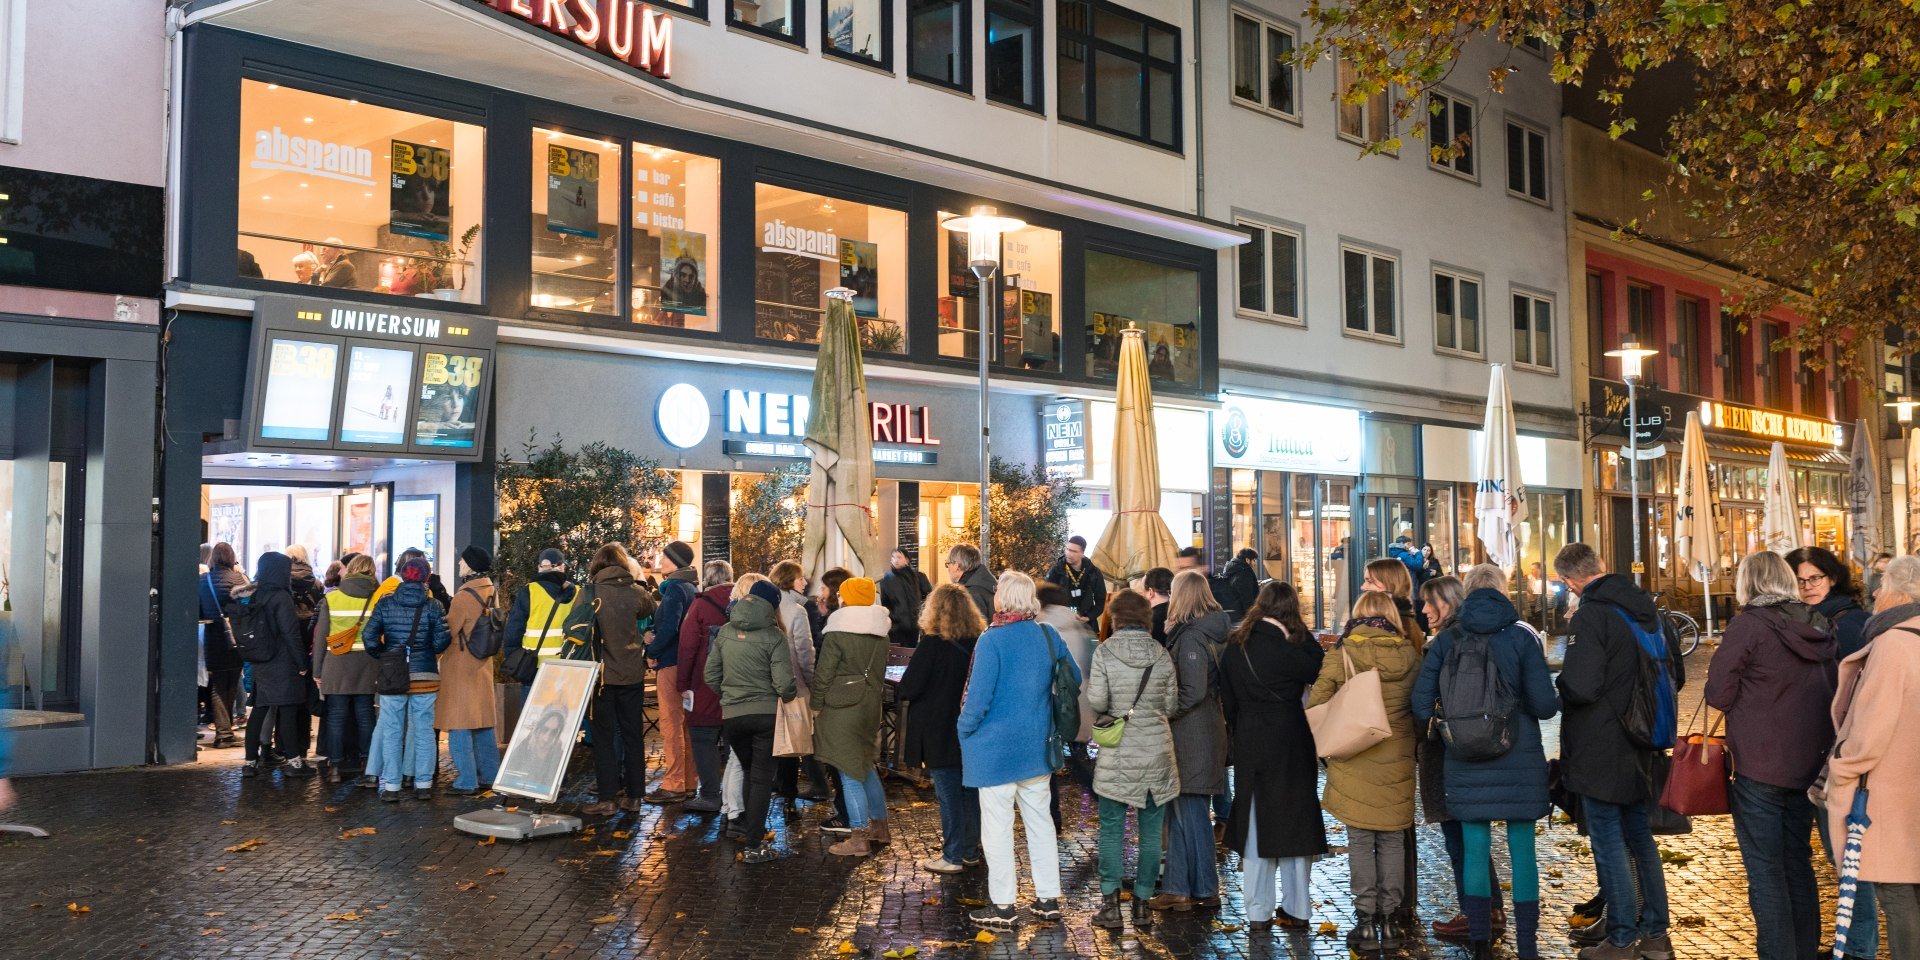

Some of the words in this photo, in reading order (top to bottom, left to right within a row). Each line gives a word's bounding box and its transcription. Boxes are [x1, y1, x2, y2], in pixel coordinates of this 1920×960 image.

[255, 126, 372, 177] abspann
[653, 169, 671, 186] bar
[653, 212, 684, 230] bistro
[764, 219, 837, 257] abspann
[1016, 241, 1028, 254] bar
[330, 308, 441, 338] UNIVERSUM
[872, 401, 940, 445] RILL
[1046, 421, 1082, 440] NEM
[1714, 403, 1784, 437] RHEINISCHE
